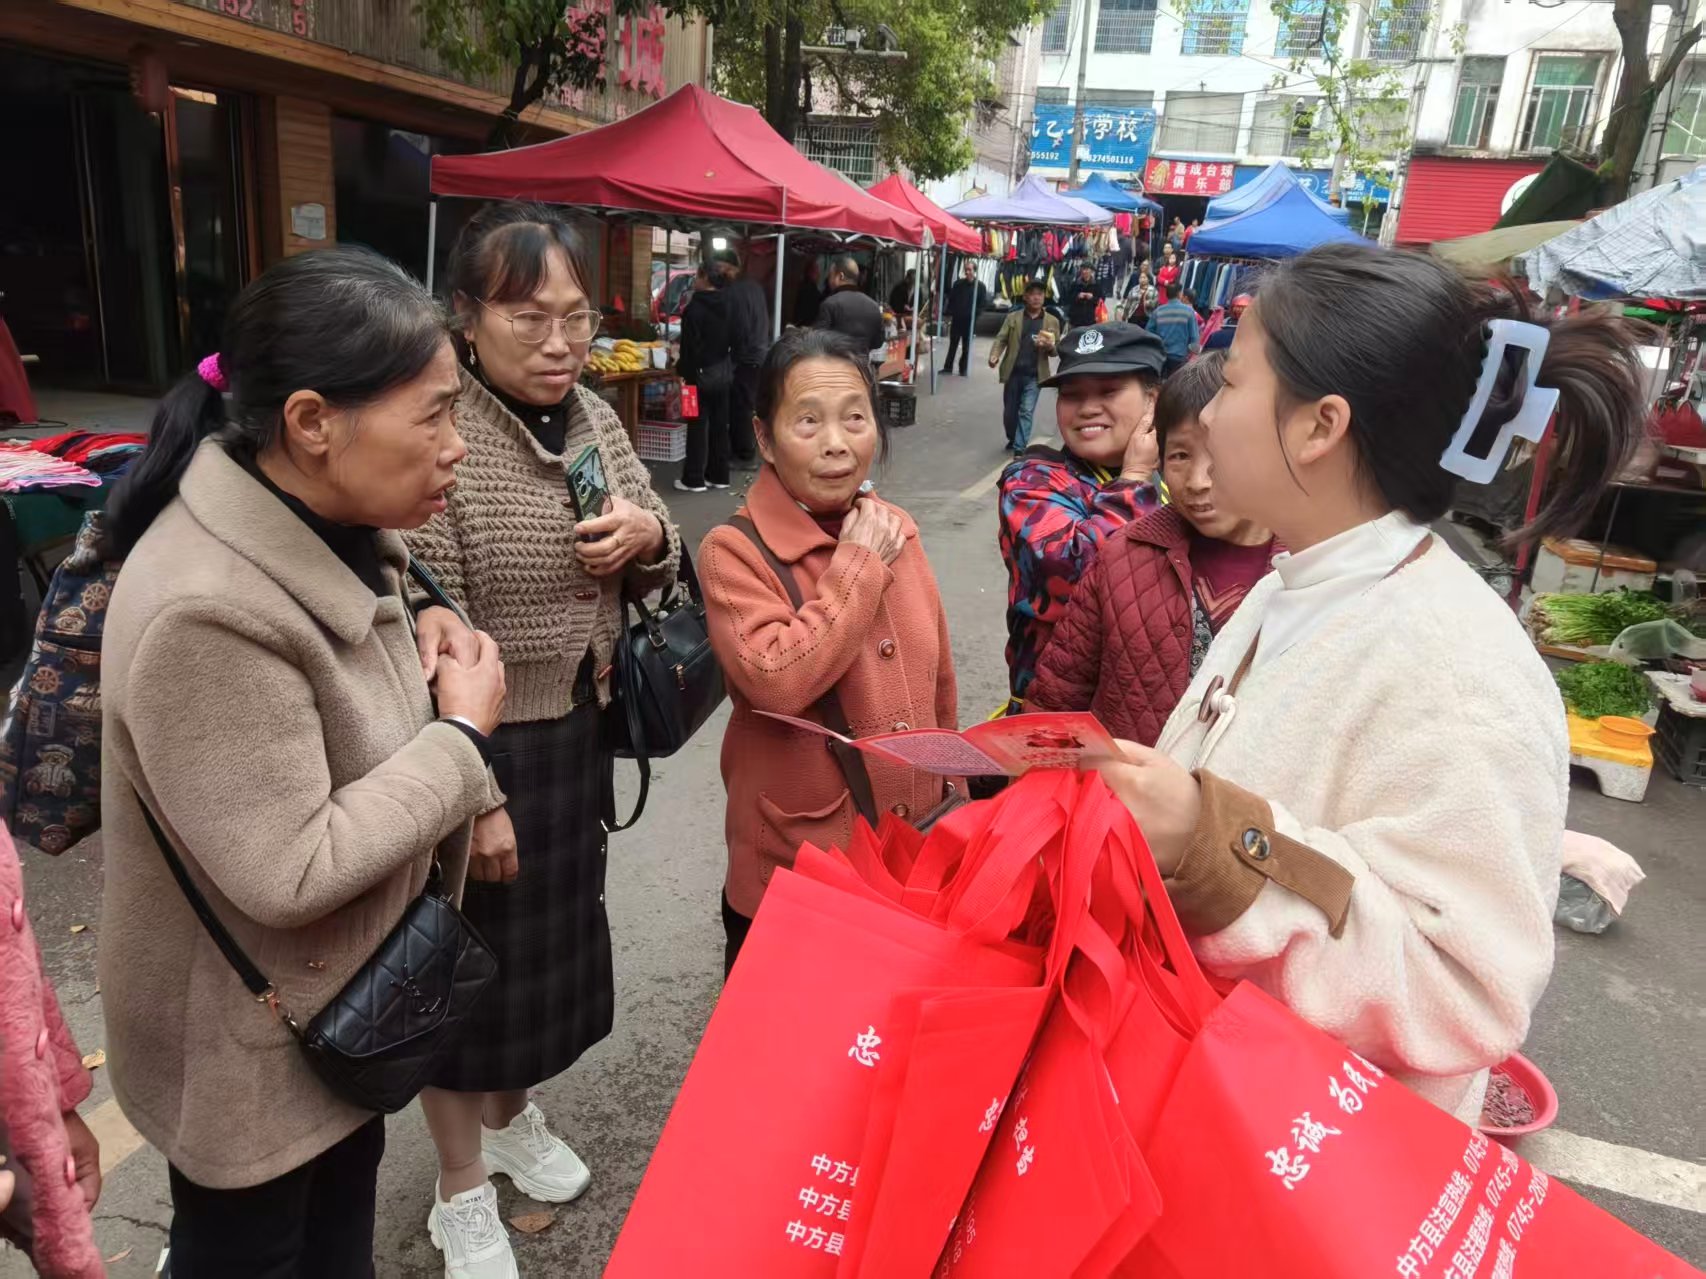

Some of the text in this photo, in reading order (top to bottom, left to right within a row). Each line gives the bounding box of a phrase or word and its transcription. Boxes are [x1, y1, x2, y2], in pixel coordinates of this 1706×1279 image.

[1082, 153, 1134, 164] 274501116
[1174, 162, 1234, 177] 嘉成台球
[1172, 176, 1232, 192] 俱乐部
[848, 1025, 882, 1067] 忠
[978, 1096, 1008, 1133] 忠
[785, 1220, 846, 1257] 中方县
